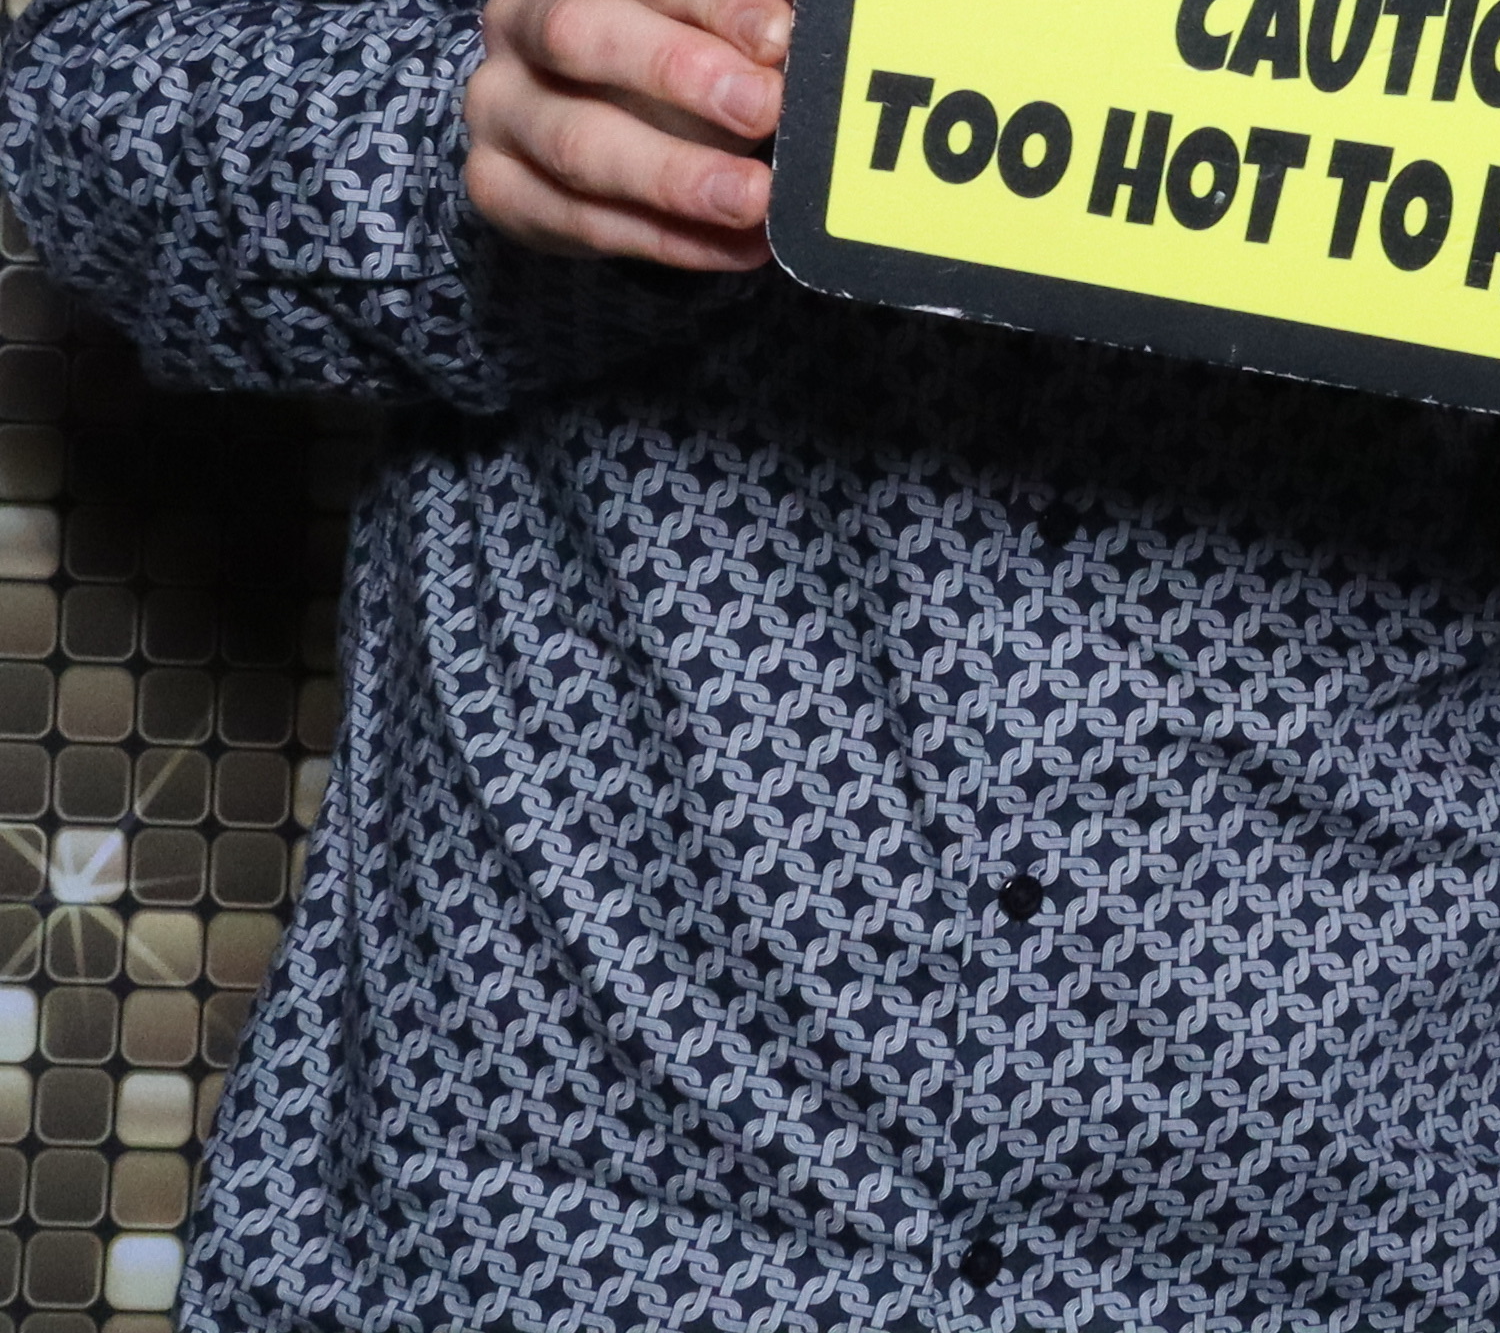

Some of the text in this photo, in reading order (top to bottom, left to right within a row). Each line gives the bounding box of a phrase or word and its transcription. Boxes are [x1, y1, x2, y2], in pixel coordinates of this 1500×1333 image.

[866, 70, 1073, 199] TOO
[1087, 107, 1311, 244] HOT
[1327, 139, 1454, 272] TO
